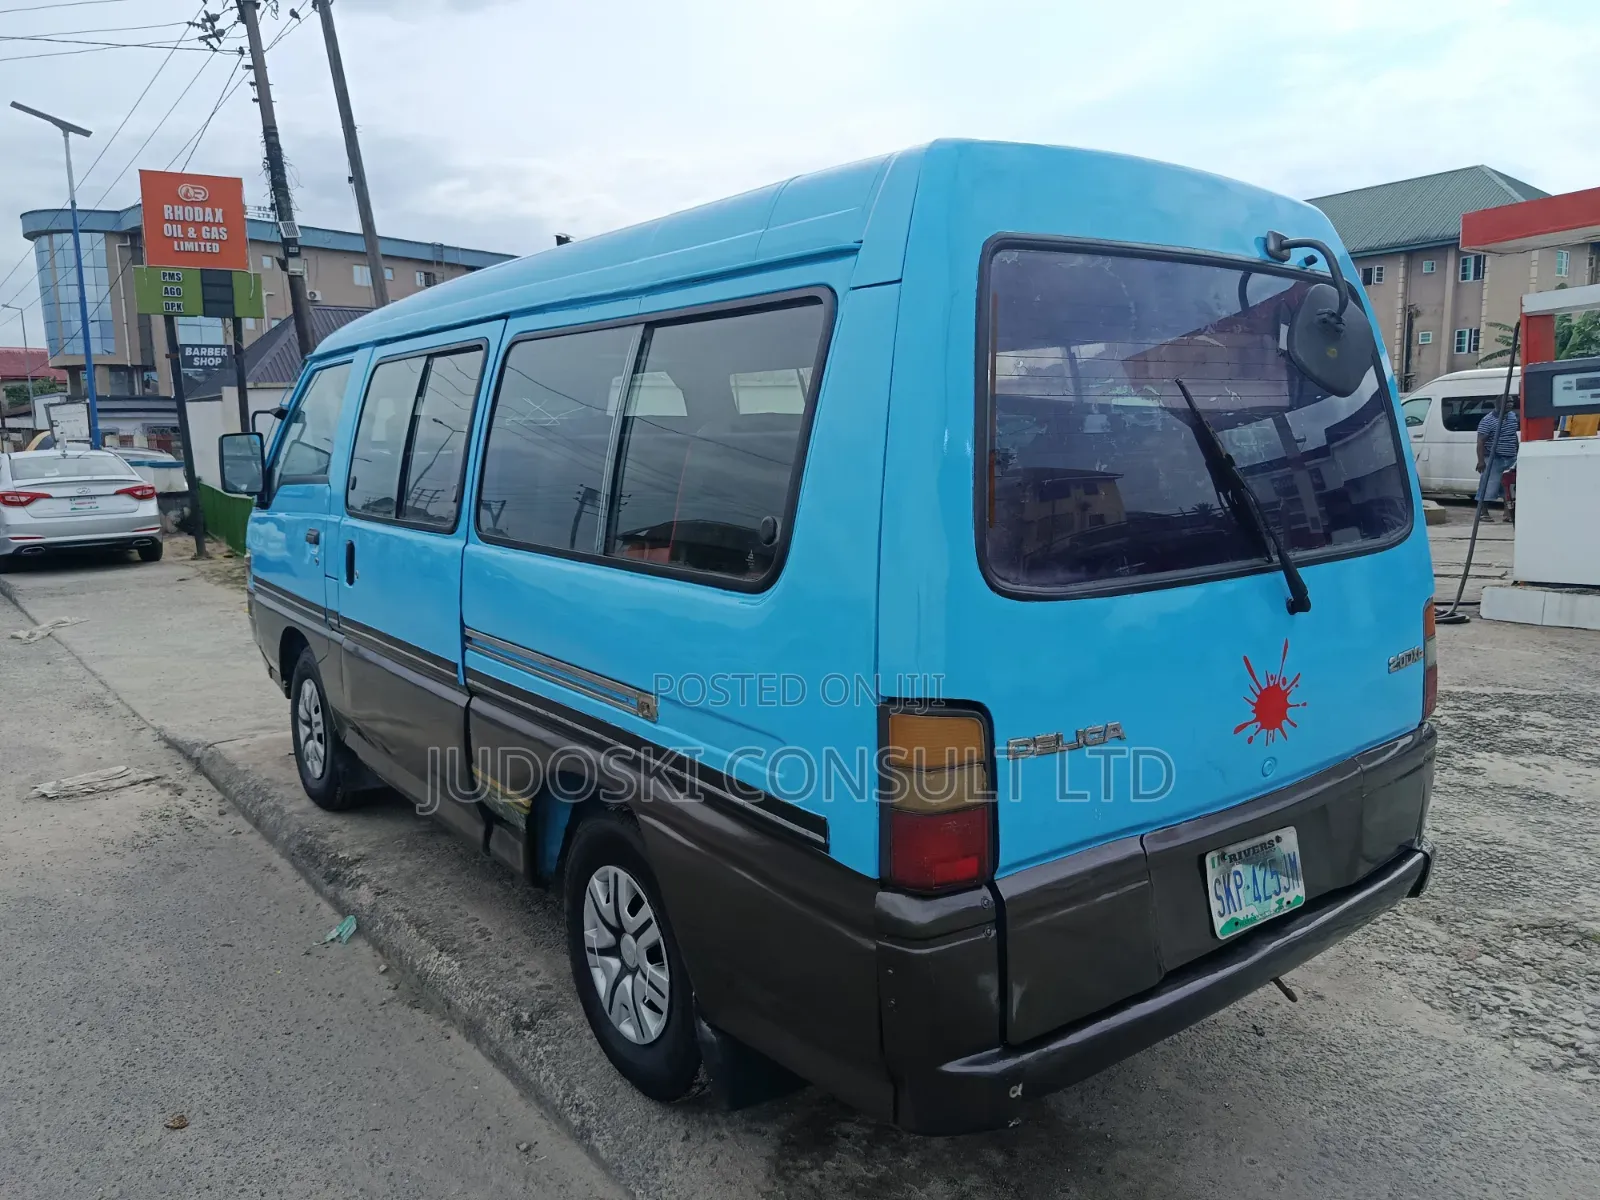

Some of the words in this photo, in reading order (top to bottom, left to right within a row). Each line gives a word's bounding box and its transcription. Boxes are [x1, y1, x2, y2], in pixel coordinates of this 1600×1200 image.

[163, 204, 224, 223] RHODAX
[163, 223, 184, 238] OIL
[187, 227, 197, 239] &
[202, 225, 228, 241] GAS
[173, 241, 220, 253] LIMITED
[161, 271, 182, 282] PMS
[163, 286, 182, 297] AGO
[164, 302, 184, 313] DPK
[185, 347, 228, 357] BARBER
[193, 357, 222, 367] SHOP
[1007, 721, 1126, 760] DELICA
[1228, 839, 1276, 864] RIVERS
